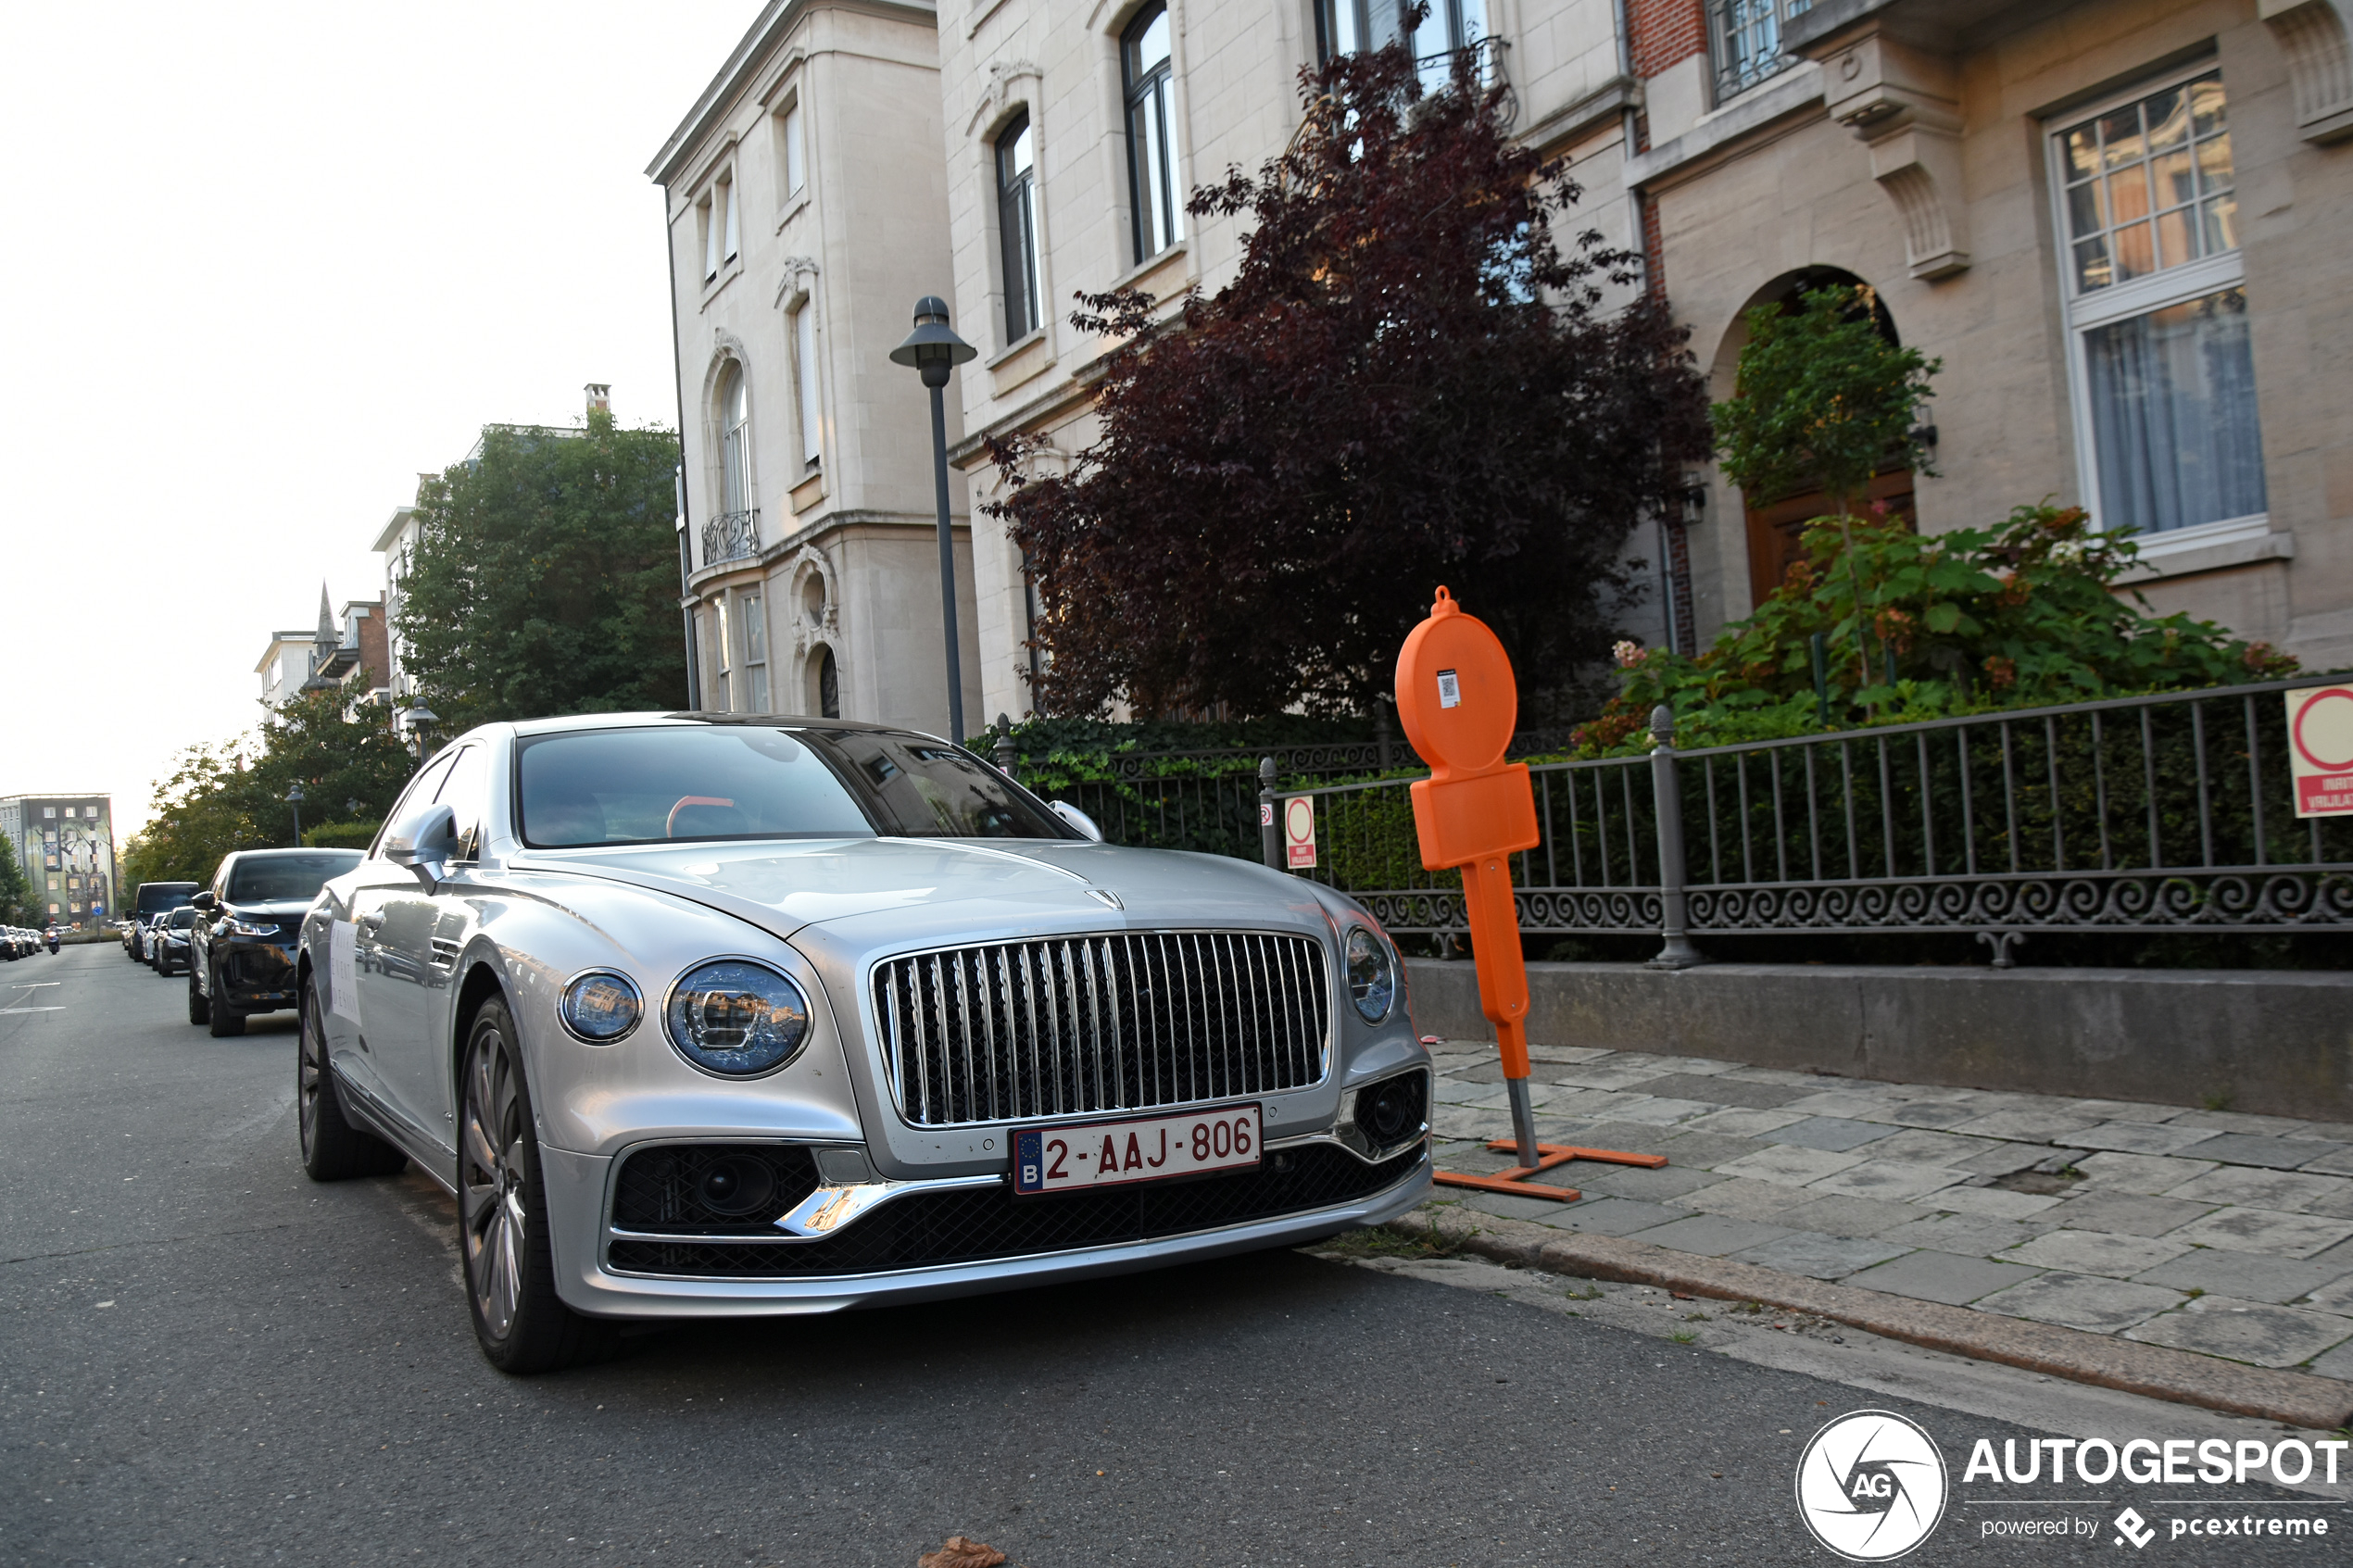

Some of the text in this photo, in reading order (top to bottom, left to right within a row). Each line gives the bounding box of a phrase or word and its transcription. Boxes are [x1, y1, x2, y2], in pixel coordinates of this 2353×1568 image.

[332, 957, 351, 982] EVENT
[333, 986, 358, 1014] DESIGN
[1046, 1117, 1251, 1180] 2-AAJ-806
[1023, 1164, 1038, 1184] B
